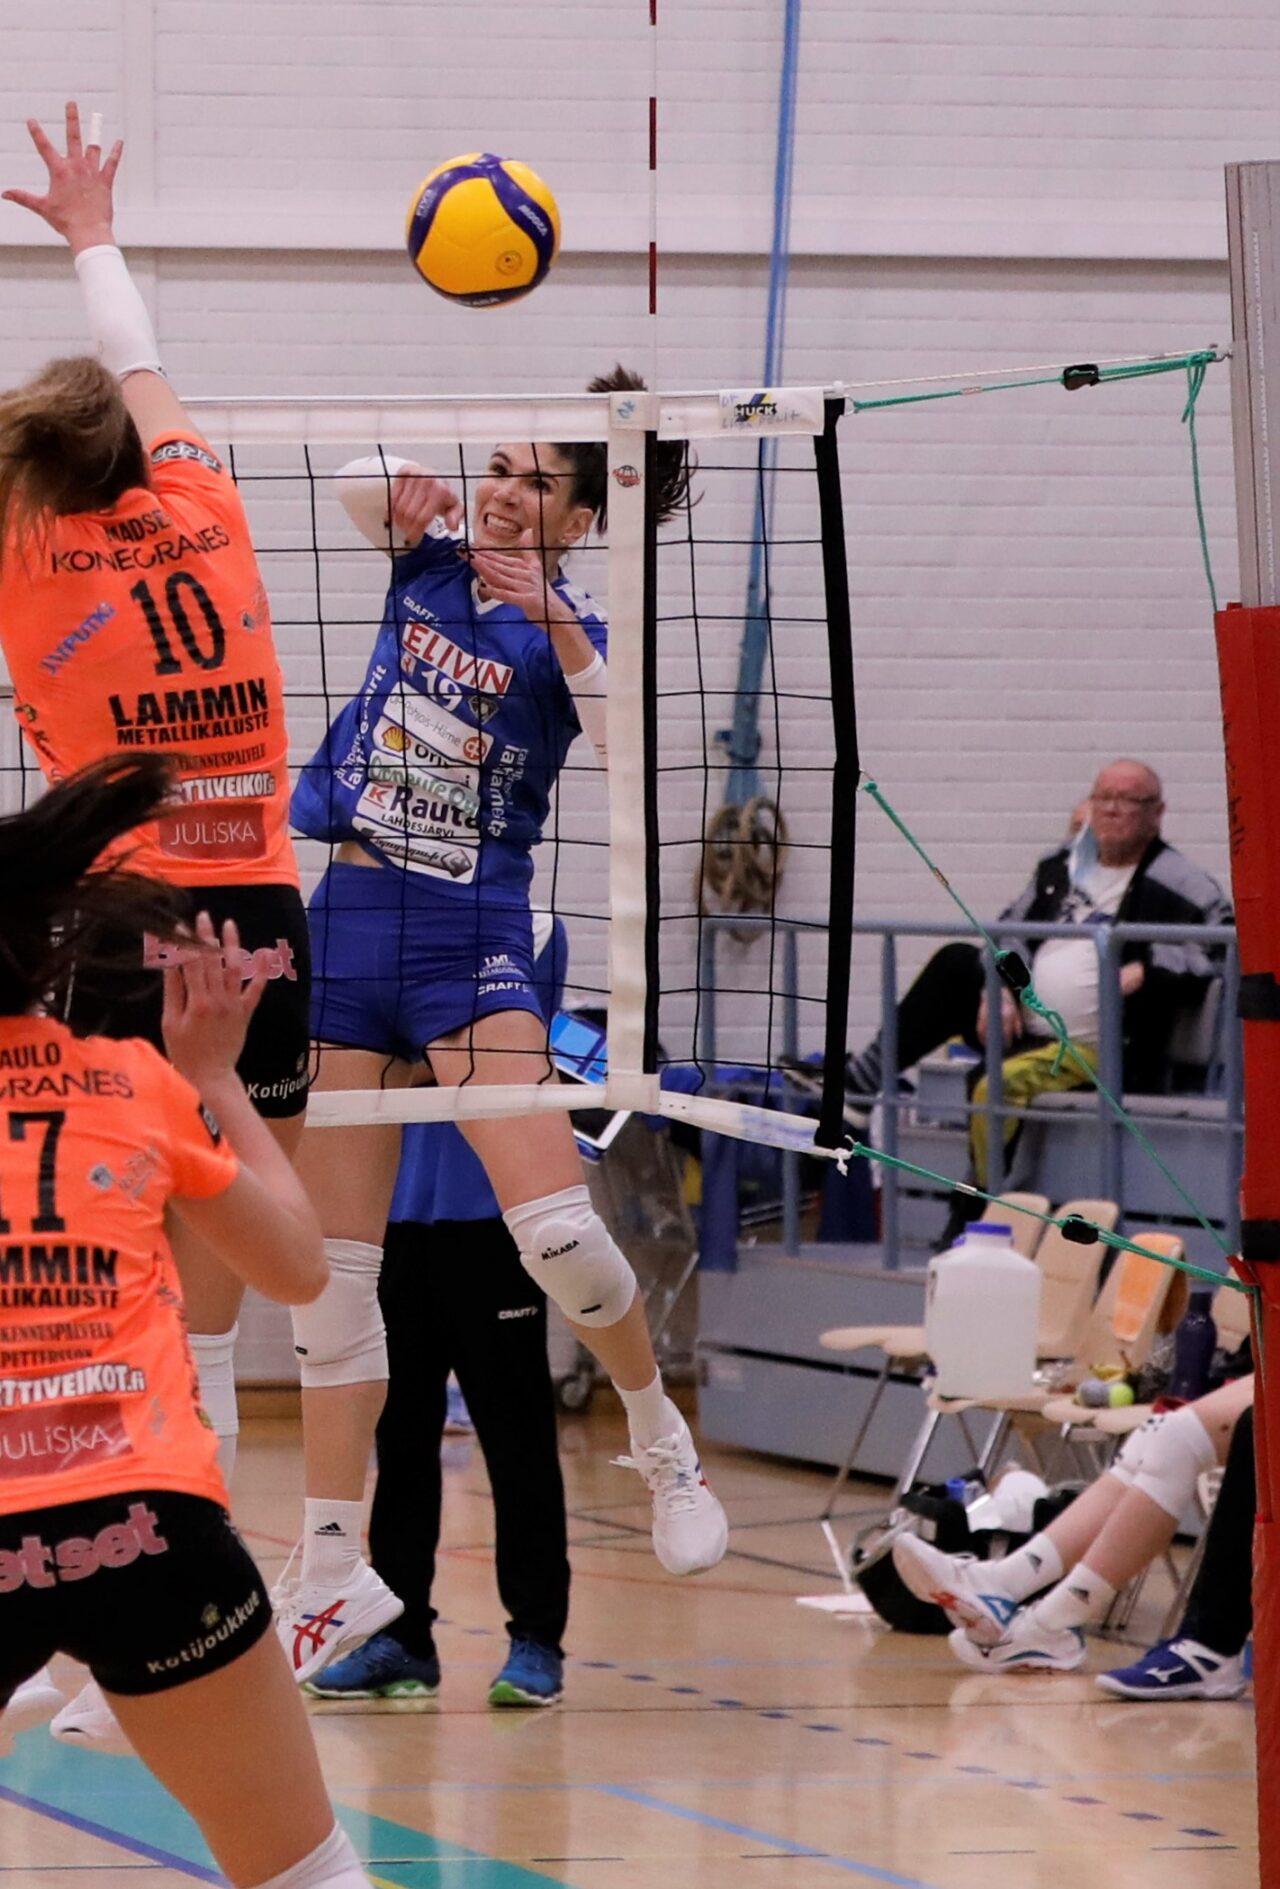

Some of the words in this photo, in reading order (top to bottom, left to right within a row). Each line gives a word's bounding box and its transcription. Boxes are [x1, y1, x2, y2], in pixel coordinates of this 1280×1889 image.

[735, 403, 777, 417] HUCK
[105, 508, 172, 543] MADSE
[130, 570, 228, 677] 10
[403, 596, 435, 621] CRAFT
[107, 677, 269, 728] LAMMIN
[420, 668, 464, 712] 19
[116, 711, 269, 746] METALLIKALUSTE
[389, 785, 481, 831] Rauta
[146, 1589, 261, 1675] Kotijoukkue
